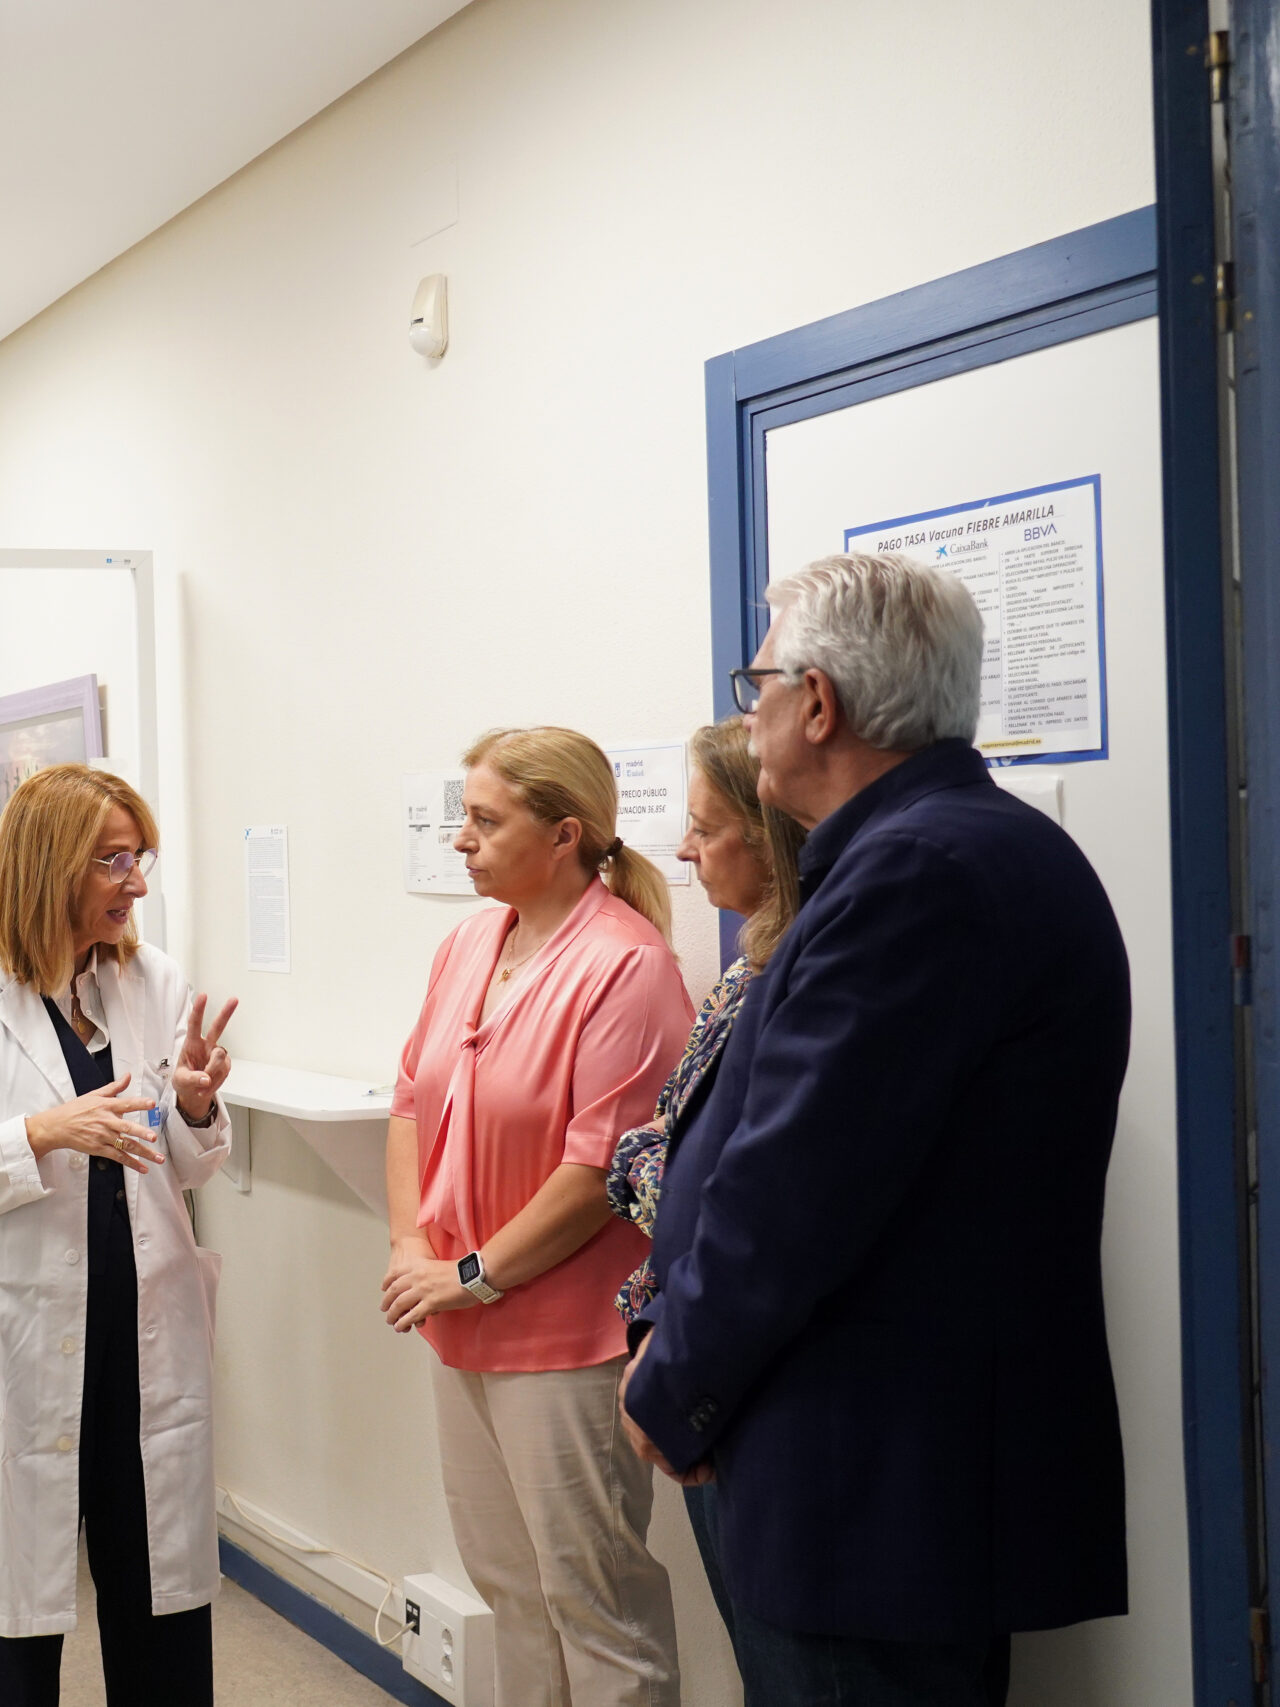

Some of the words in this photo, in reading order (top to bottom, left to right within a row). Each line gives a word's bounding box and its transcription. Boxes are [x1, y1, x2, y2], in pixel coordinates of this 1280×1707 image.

[877, 537, 902, 553] PAGO
[904, 532, 926, 547] TASA
[929, 526, 964, 542] Vacuna
[966, 516, 1001, 535] FIEBRE
[1002, 504, 1055, 527] AMARILLA
[1023, 522, 1058, 542] BBVA
[949, 537, 989, 555] CaixaBank
[621, 789, 641, 798] PRECIO
[642, 786, 667, 798] PÚBLICO
[616, 806, 646, 815] CUNACION
